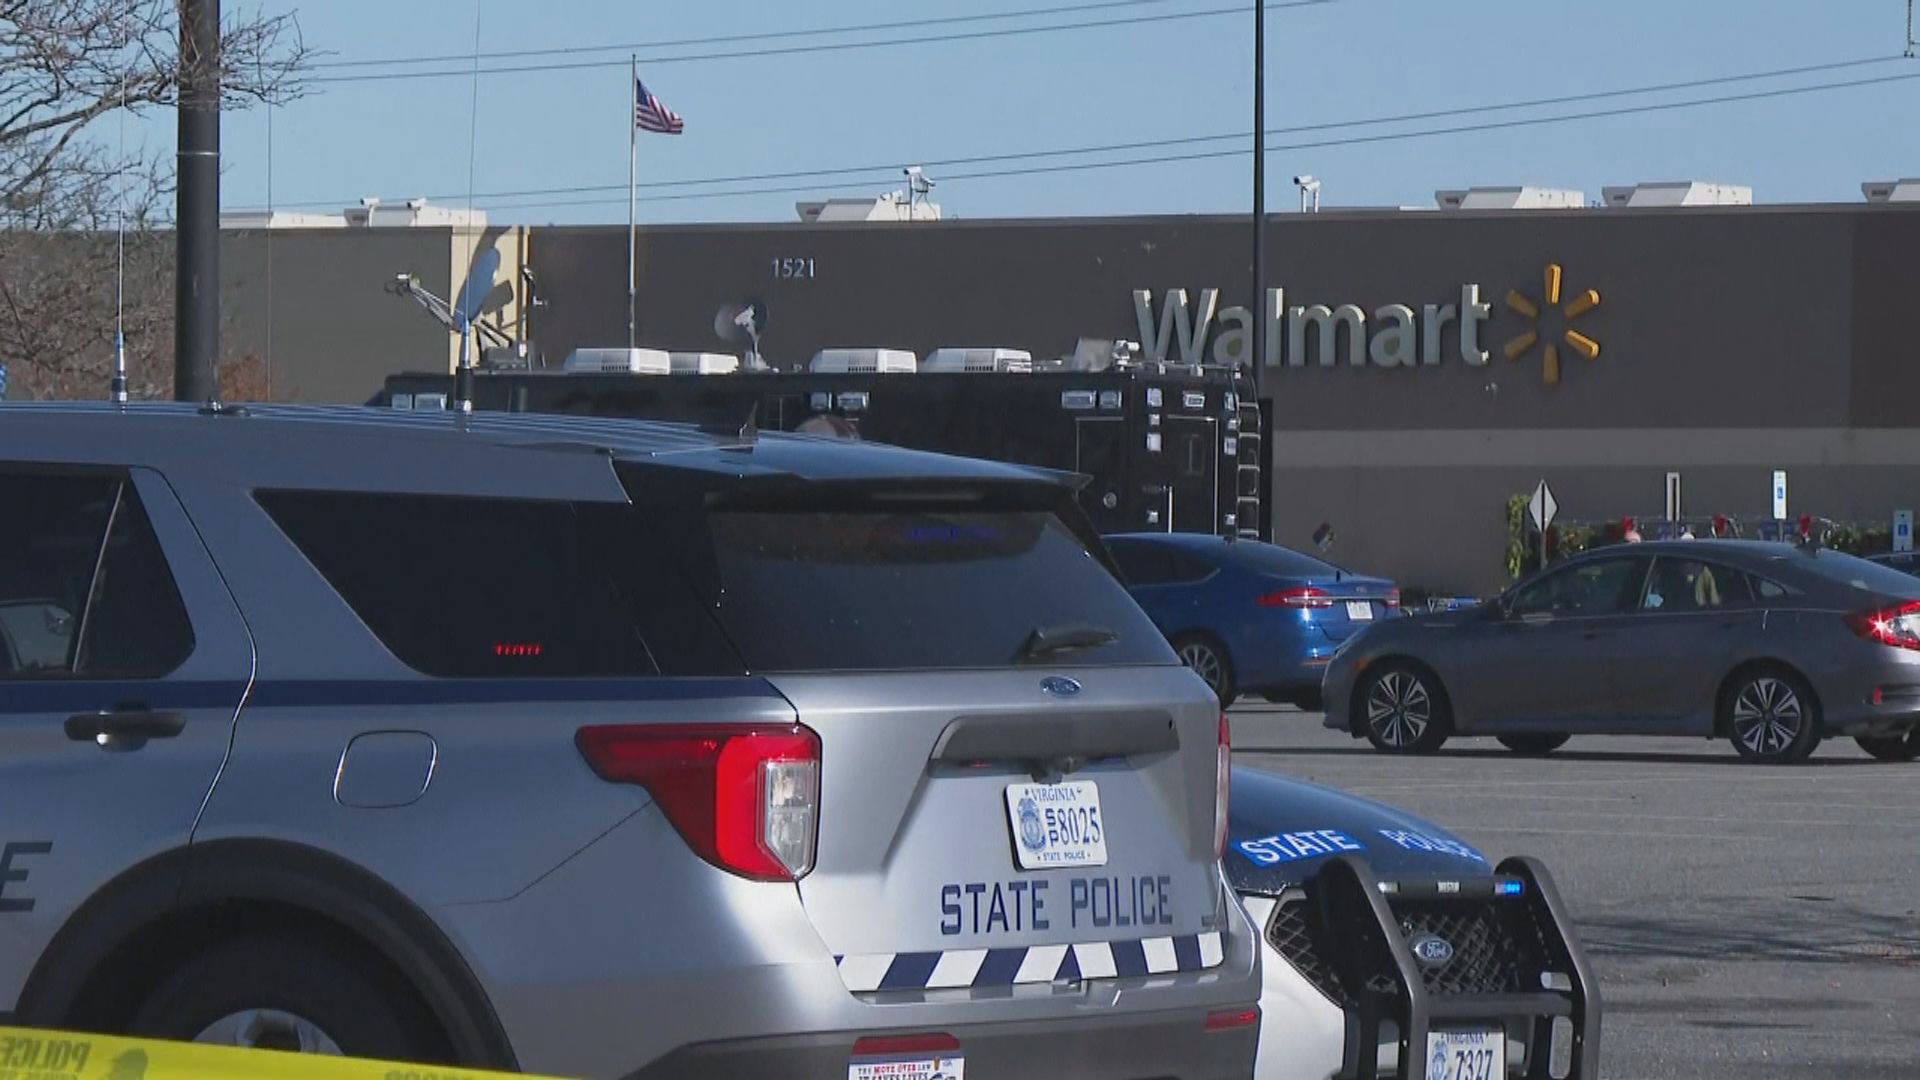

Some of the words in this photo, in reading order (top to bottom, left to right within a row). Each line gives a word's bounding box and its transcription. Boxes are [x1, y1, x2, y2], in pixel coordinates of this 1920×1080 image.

[771, 257, 815, 279] 1521
[1132, 283, 1490, 369] Walmart
[1032, 787, 1076, 801] VIRGINIA
[1057, 806, 1100, 846] 8025
[1043, 851, 1061, 861] STATE
[1064, 850, 1086, 860] POLICE
[1240, 829, 1360, 863] STATE
[940, 879, 1051, 936] STATE
[1070, 875, 1174, 930] POLICE
[873, 1065, 896, 1074] MOVE
[897, 1064, 917, 1073] OVER
[1456, 1049, 1493, 1080] 7327
